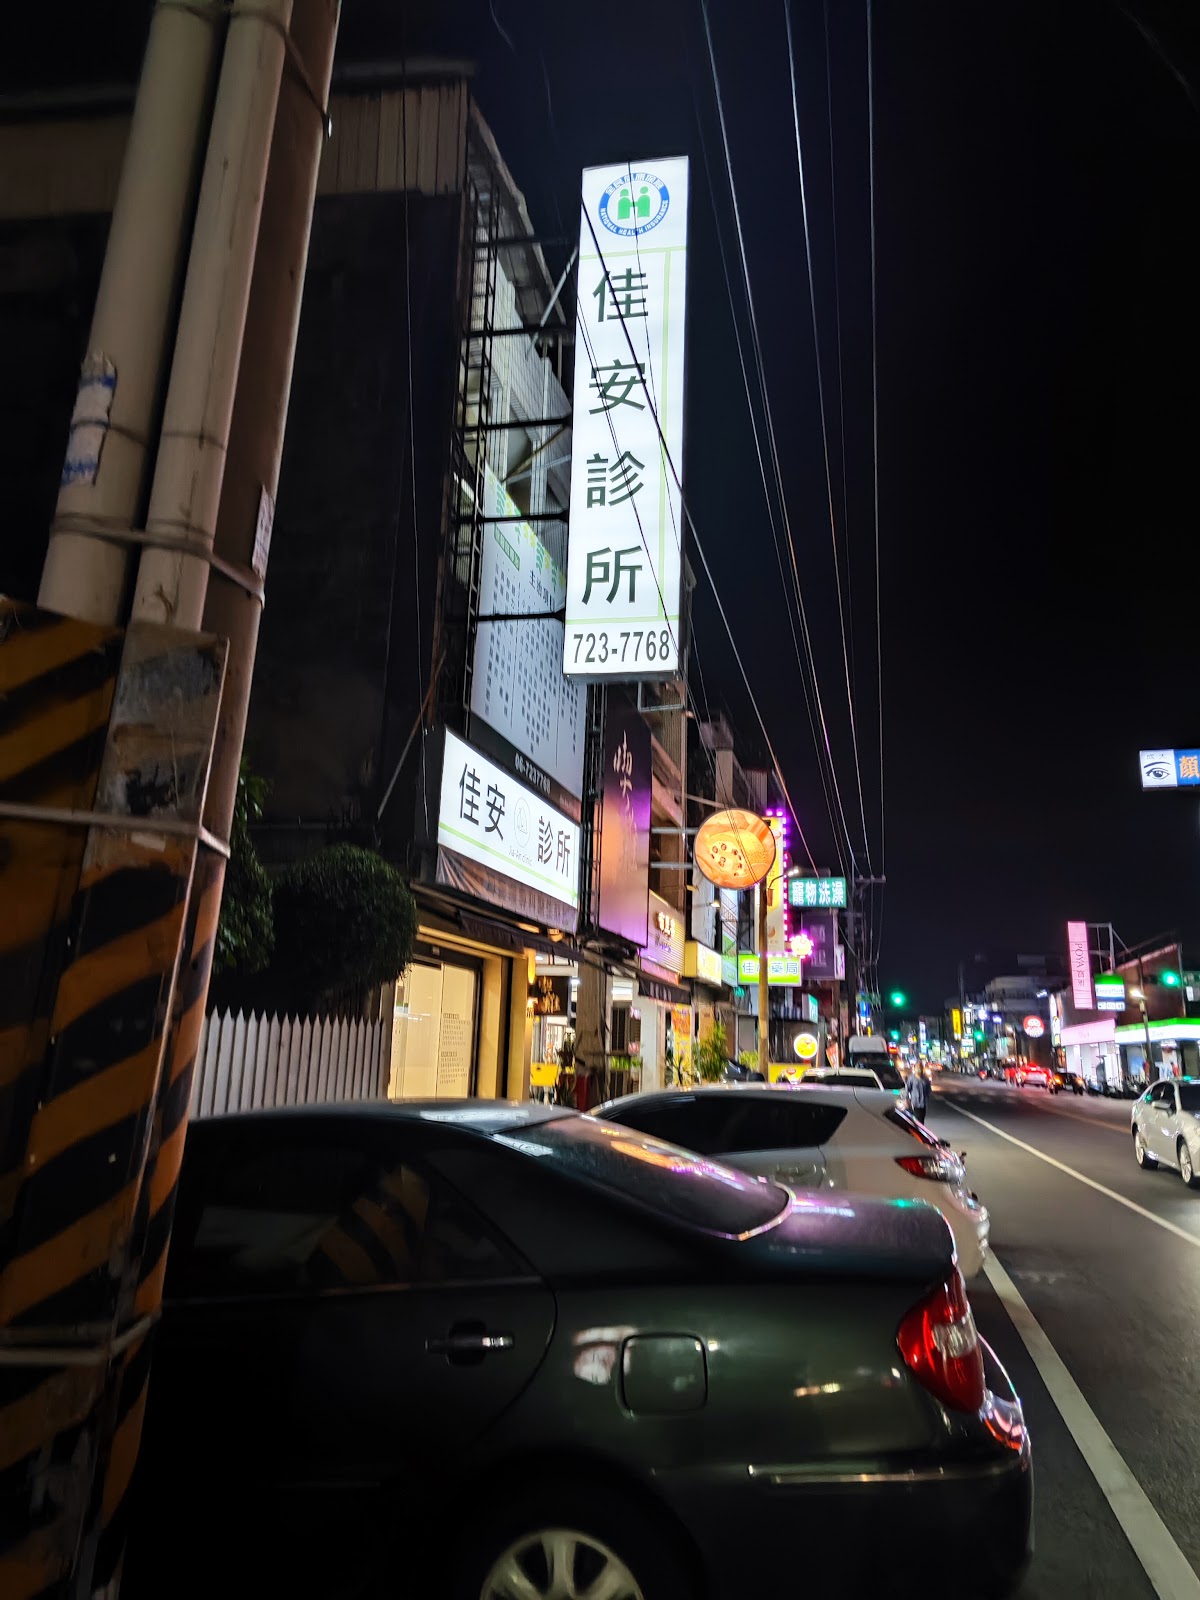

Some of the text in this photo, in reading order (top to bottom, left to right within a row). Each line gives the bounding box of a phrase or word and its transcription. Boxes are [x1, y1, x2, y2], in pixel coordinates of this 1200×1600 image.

[644, 199, 669, 232] INSURANCE
[581, 267, 649, 605] 佳安診所
[573, 630, 670, 664] 723-7768
[514, 752, 551, 796] 06-7237768
[459, 762, 571, 878] 佳安 診所
[742, 962, 798, 974] 佳藥局
[1074, 943, 1085, 968] POYA
